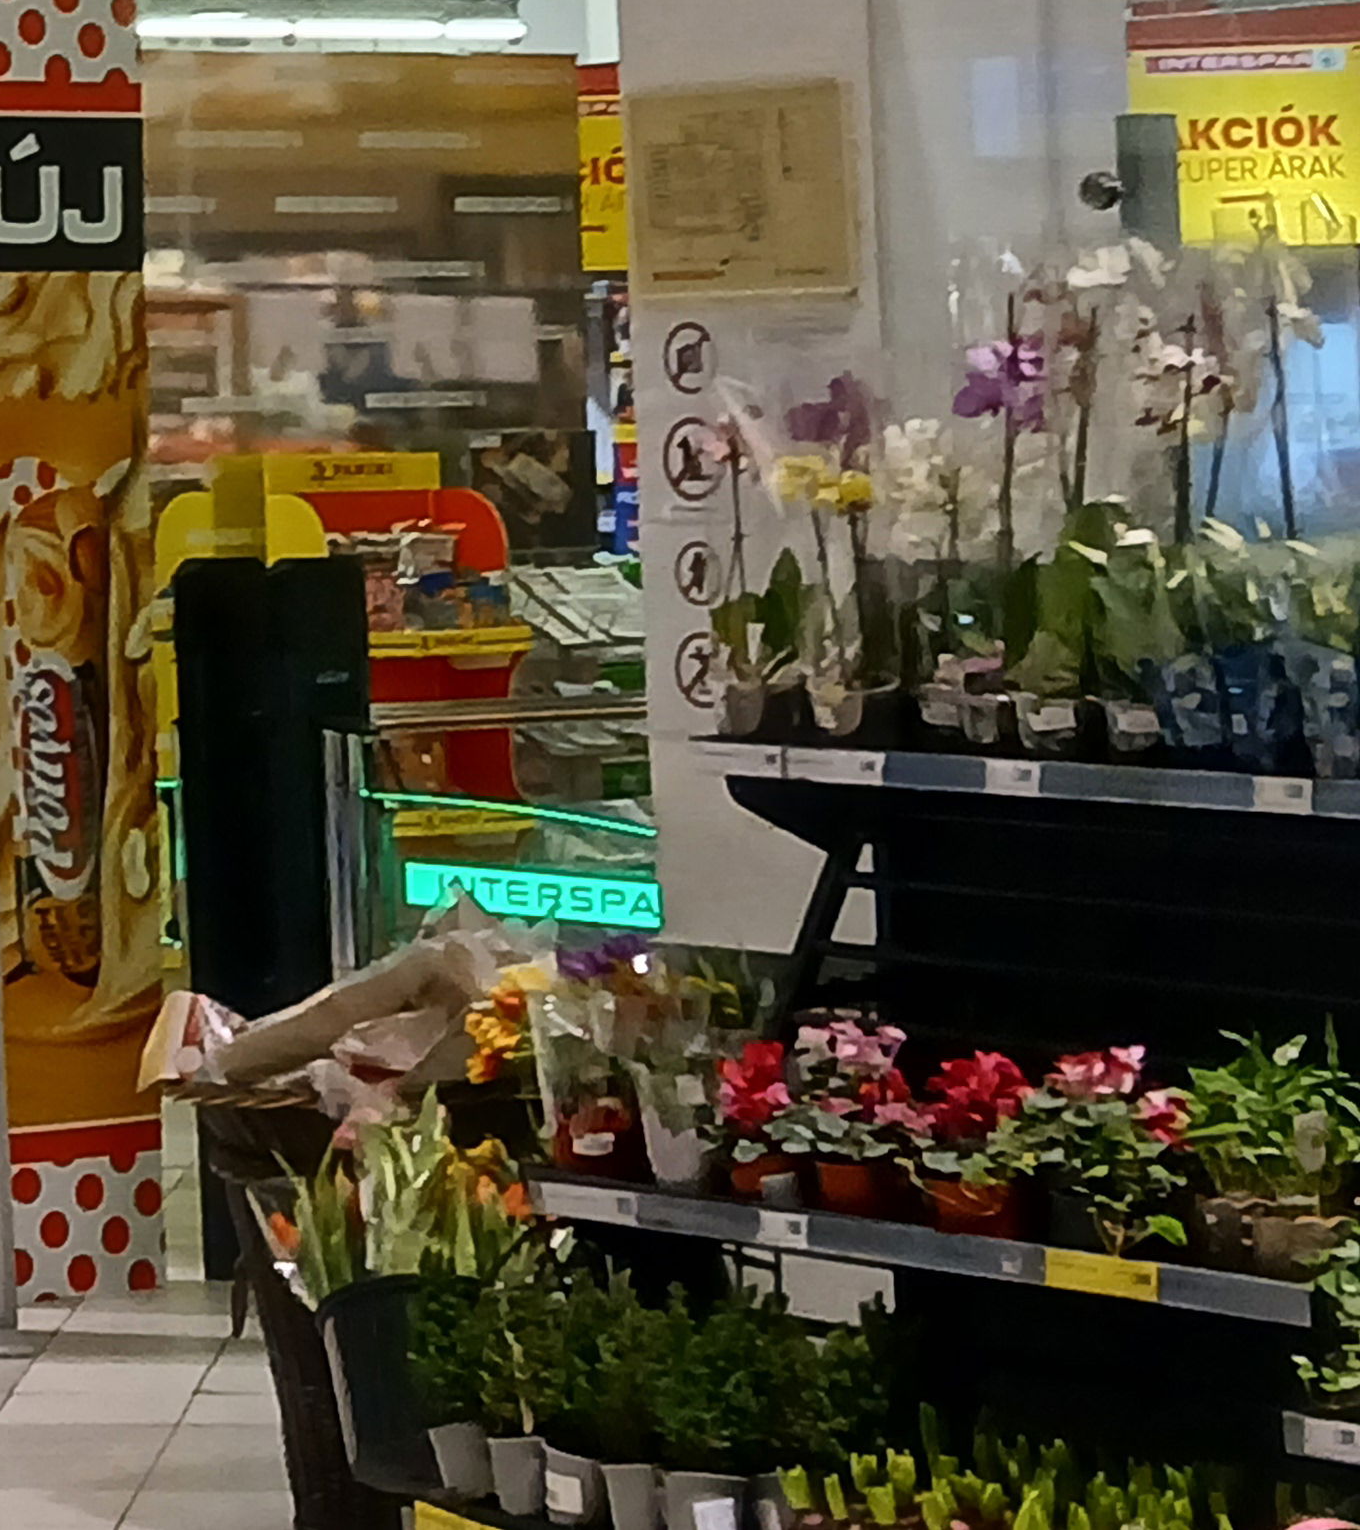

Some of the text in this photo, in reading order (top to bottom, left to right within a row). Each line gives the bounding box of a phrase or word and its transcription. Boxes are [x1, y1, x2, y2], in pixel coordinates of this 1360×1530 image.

[1177, 103, 1342, 151] KCIÓK
[1178, 151, 1347, 183] UPER ÁRAK
[438, 872, 655, 917] INTERSPA
